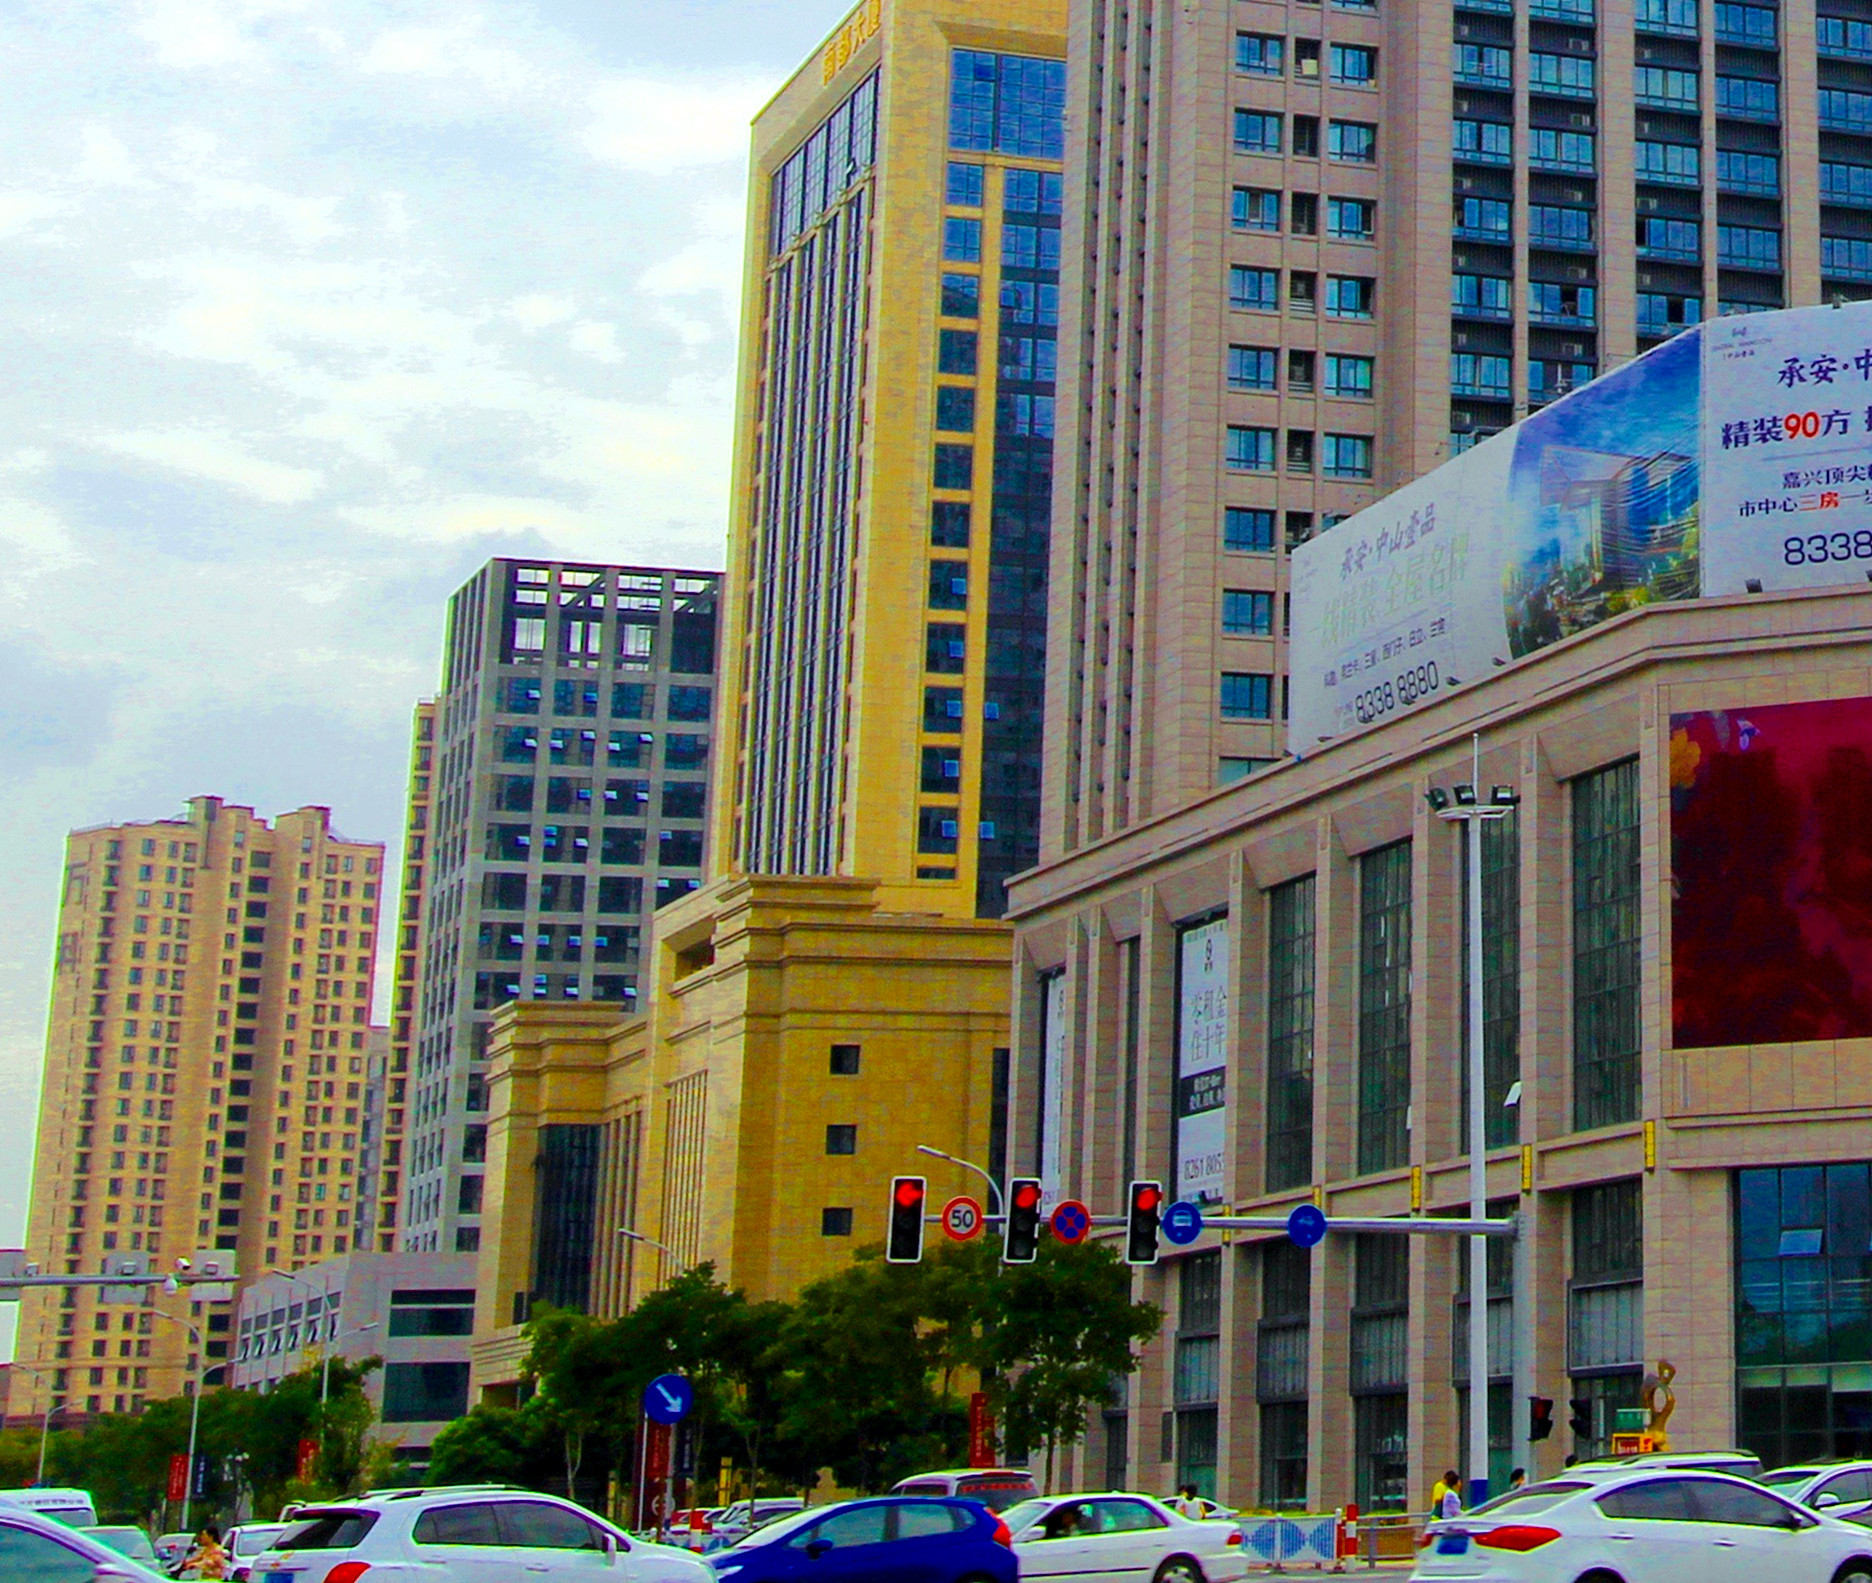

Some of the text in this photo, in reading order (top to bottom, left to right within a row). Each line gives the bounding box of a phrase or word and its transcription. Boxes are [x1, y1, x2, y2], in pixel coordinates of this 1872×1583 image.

[1722, 410, 1851, 450] 精装90方
[1355, 681, 1395, 724] 8338
[1397, 660, 1439, 704] 8880
[952, 1209, 974, 1228] 50
